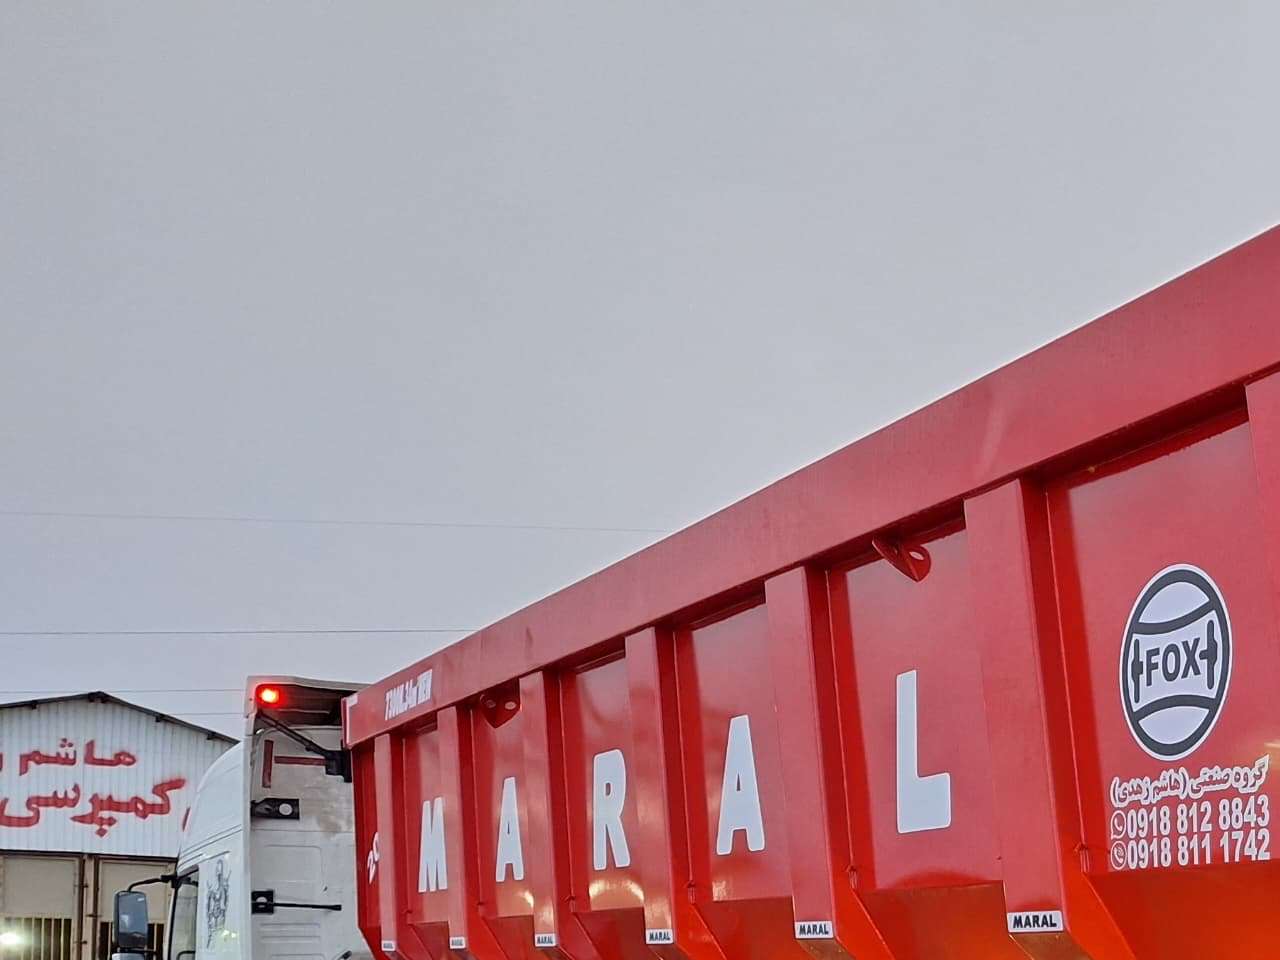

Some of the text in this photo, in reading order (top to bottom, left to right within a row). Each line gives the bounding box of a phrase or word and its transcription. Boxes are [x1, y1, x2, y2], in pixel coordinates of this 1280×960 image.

[1146, 637, 1201, 687] FOX
[19, 737, 137, 776] هاشم
[1127, 794, 1270, 838] 0918 812 8843
[1127, 828, 1271, 870] 0918 811 1742
[649, 931, 671, 942] MARAL
[799, 923, 829, 936] MARAL
[1012, 914, 1058, 930] MARAL
